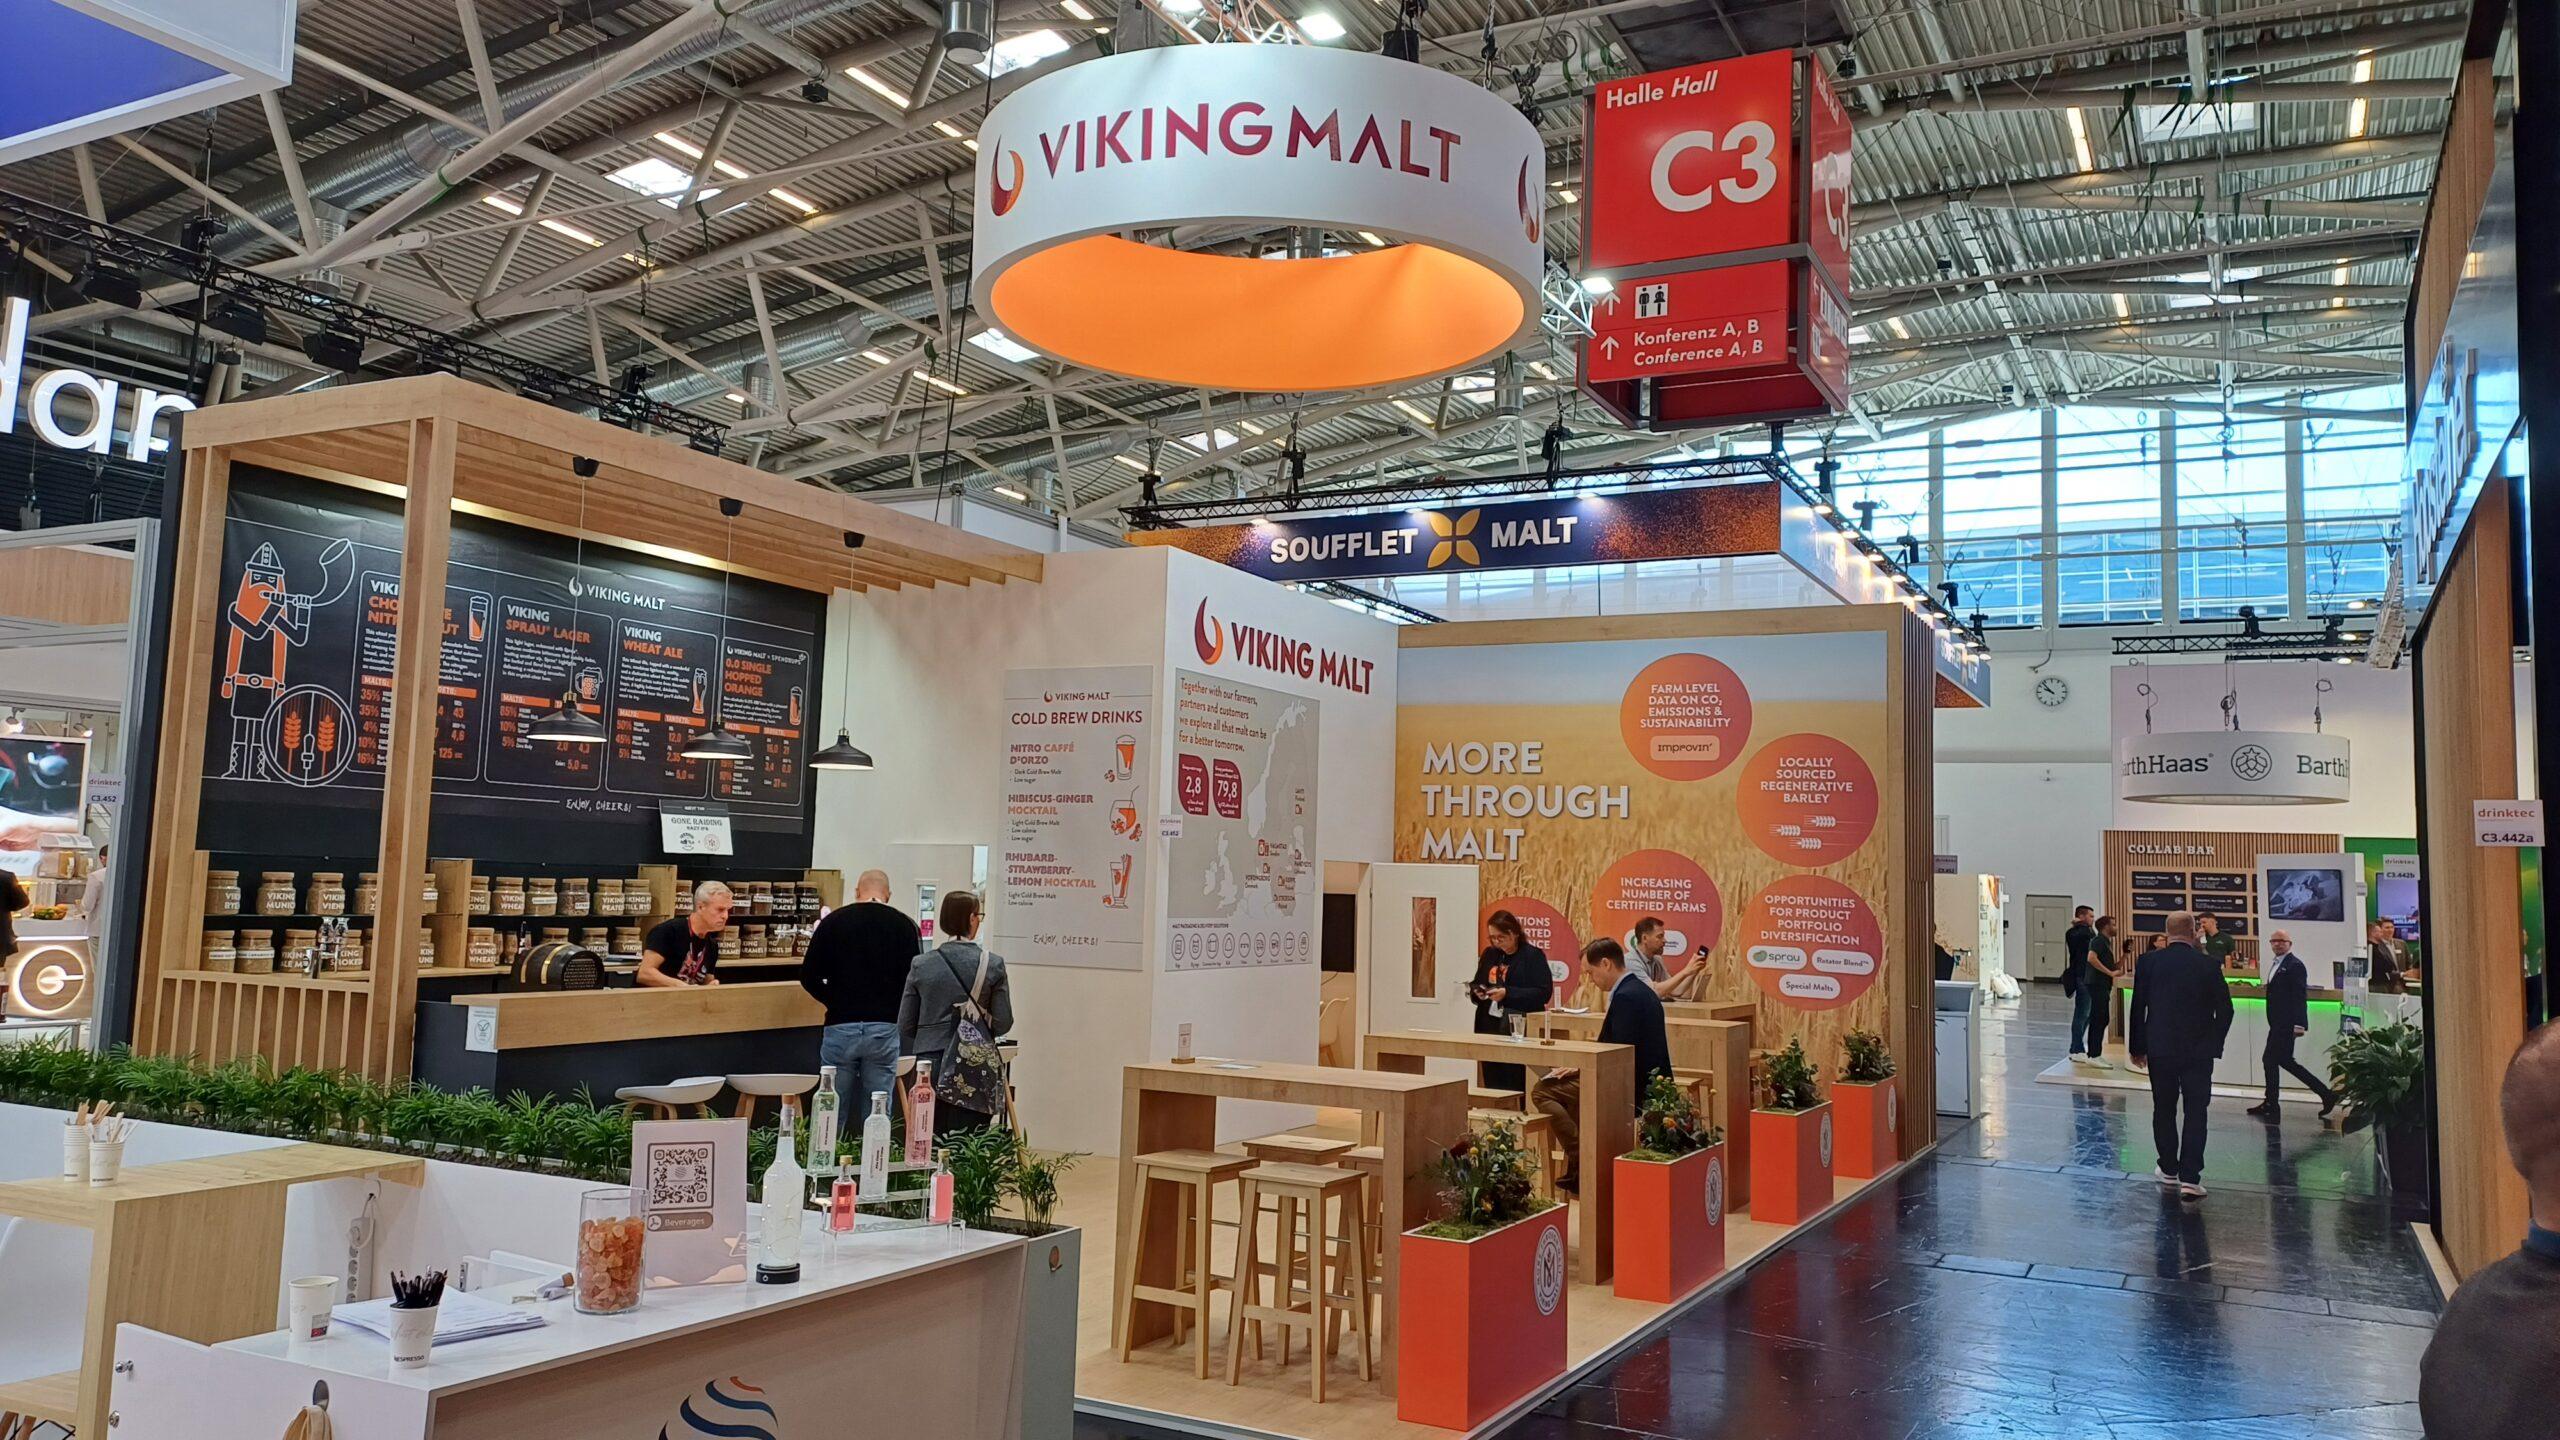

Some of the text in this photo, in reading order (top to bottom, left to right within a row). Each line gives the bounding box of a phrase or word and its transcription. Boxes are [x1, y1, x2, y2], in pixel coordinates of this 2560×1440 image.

[1606, 70, 1719, 109] Halle Hall
[1038, 101, 1461, 183] VIKING MALT
[1651, 120, 1777, 212] C3
[1634, 319, 1760, 346] Konferenz A, B
[1633, 339, 1763, 366] Conference A, B
[1270, 516, 1578, 564] SOUFFLET MALT
[586, 583, 665, 611] VIKING MALT
[507, 604, 550, 622] VIKING
[553, 627, 592, 644] LAGER
[624, 625, 662, 642] VIKING
[623, 639, 683, 659] WHEAT ALE
[1231, 622, 1374, 695] VIKING MALT
[741, 661, 772, 674] SINGLE
[725, 671, 762, 684] HOPPED
[724, 682, 763, 697] ORANGE
[1181, 677, 1258, 707] Together with our farmers,
[1651, 683, 1720, 694] FARM LEVEL
[1055, 692, 1110, 701] VIKING MALT
[1648, 695, 1678, 705] DATA
[1680, 695, 1698, 705] ON
[1180, 699, 1249, 720] partners and customers
[1648, 706, 1723, 717] EMISSIONS &
[1011, 710, 1143, 725] COLD BREW DRINKS
[1640, 718, 1731, 728] SUSTAINABILITY
[1179, 717, 1188, 725] we
[1189, 716, 1212, 731] explore
[1222, 720, 1234, 734] that
[1235, 724, 1248, 737] malt
[1249, 729, 1259, 738] can
[1260, 728, 1266, 739] be
[1179, 730, 1245, 752] for better tomorrow.
[1010, 744, 1041, 753] NITRO
[1422, 741, 1543, 774] MORE
[1780, 757, 1833, 767] LOCALLY
[1776, 769, 1837, 779] SOURCED
[1185, 775, 1201, 798] 2,8
[1217, 779, 1238, 802] 79,8
[1760, 781, 1854, 792] REGENERATIVE
[1008, 794, 1094, 803] HIBISCUS-GINGER
[1420, 784, 1630, 818] THROUGH
[1783, 793, 1830, 804] BARLEY
[1007, 806, 1058, 815] MOCKTAIL
[2478, 808, 2535, 818] drinktec
[671, 817, 692, 825] GONE
[1420, 827, 1525, 861] MALT
[2481, 833, 2534, 843] C3.442a
[2128, 844, 2215, 855] COLLAB BAR
[1044, 878, 1096, 888] MOCKTAIL
[1620, 877, 1692, 889] INCREASING
[1622, 889, 1691, 900] NUMBER OF
[1606, 900, 1707, 913] CERTIFIED FARMS
[1764, 895, 1856, 908] OPPORTUNITIES
[1769, 907, 1851, 920] FOR PRODUCT
[1777, 919, 1843, 932] PORTFOLIO
[1760, 931, 1860, 945] DIVERSIFICATION
[1768, 952, 1801, 964] sprau
[1816, 957, 1842, 965] Rotator
[1785, 981, 1834, 992] Special Malts
[664, 1217, 705, 1227] Beverages
